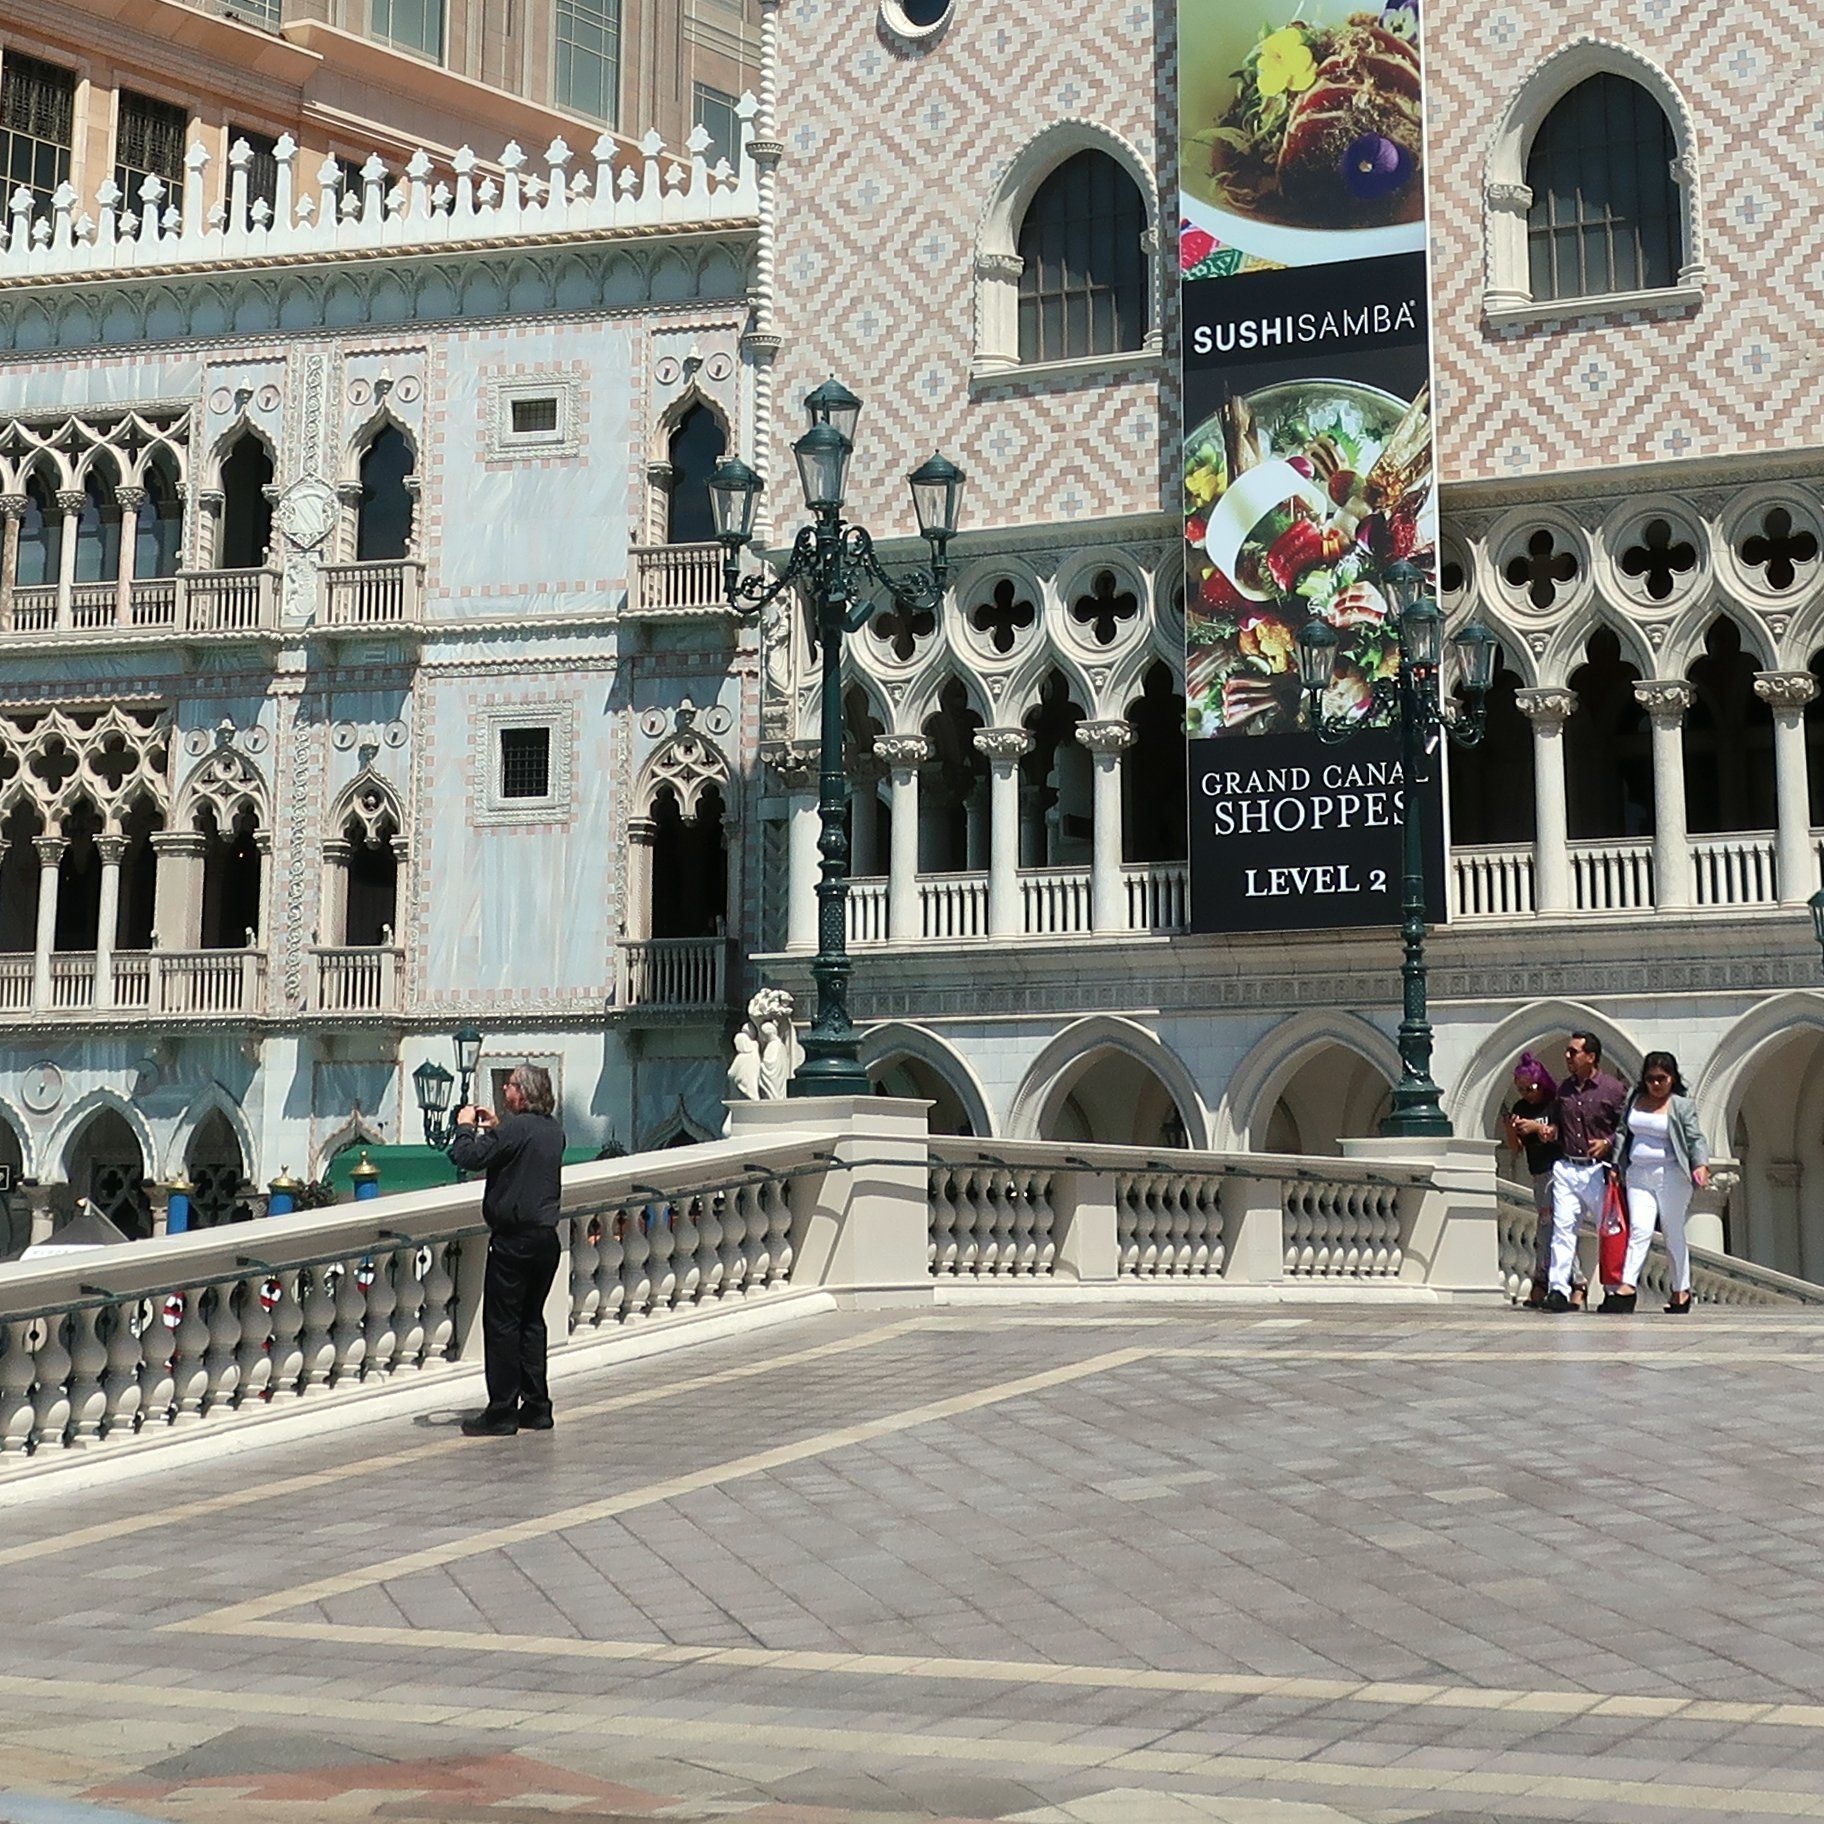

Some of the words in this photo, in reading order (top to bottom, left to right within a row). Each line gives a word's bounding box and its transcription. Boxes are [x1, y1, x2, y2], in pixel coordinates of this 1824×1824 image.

[1201, 767, 1311, 796] GRAND
[1322, 761, 1430, 789] CANA
[1244, 865, 1360, 897] LEVEL
[1369, 869, 1388, 893] 2
